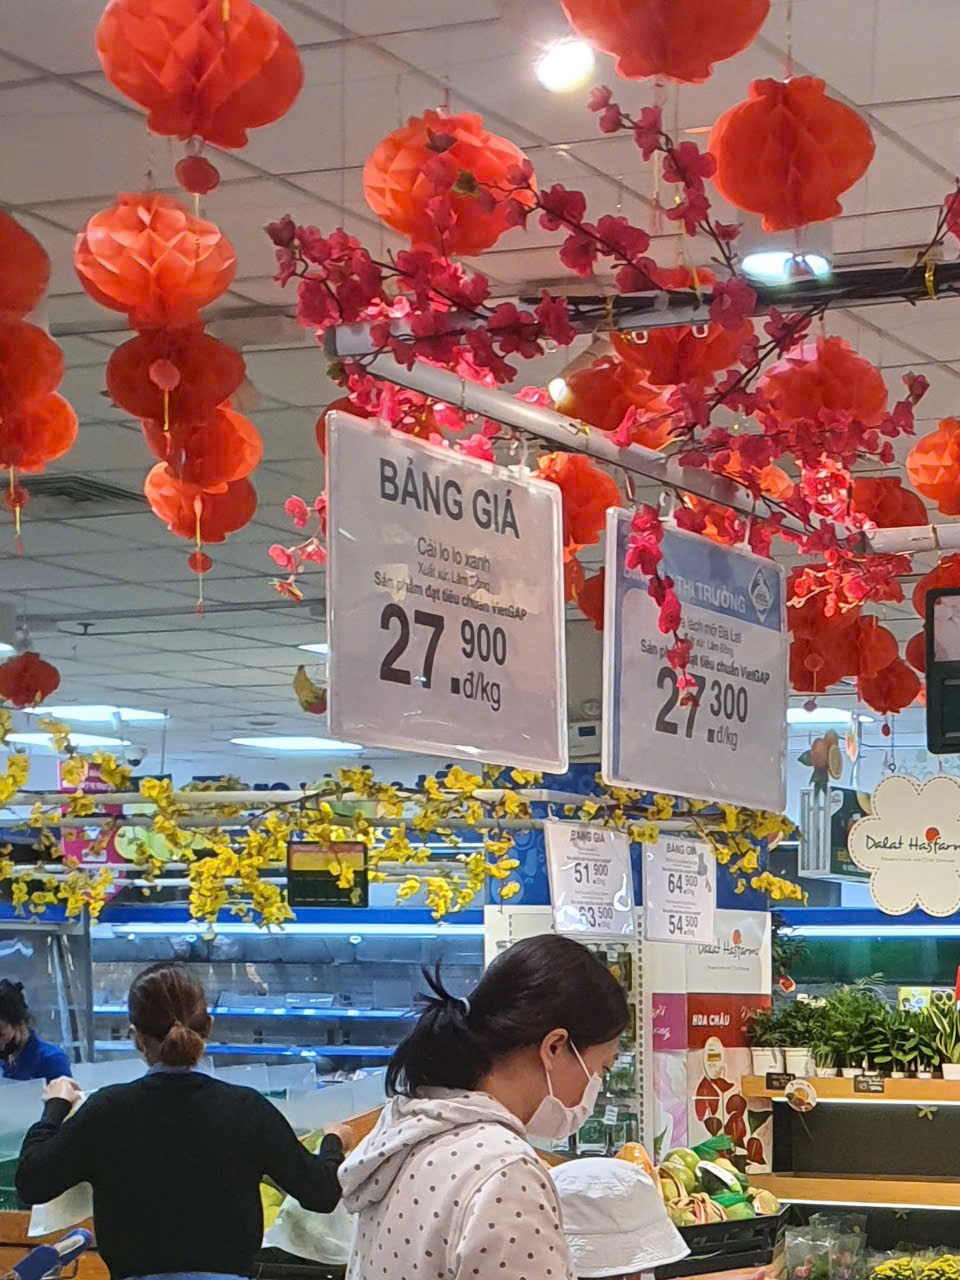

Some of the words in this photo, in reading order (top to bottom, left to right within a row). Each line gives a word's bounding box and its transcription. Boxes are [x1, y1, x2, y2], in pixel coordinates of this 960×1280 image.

[380, 457, 463, 521] BẢNG
[472, 489, 520, 539] GIÁ
[465, 554, 491, 573] xanh
[425, 584, 440, 602] đạt
[696, 581, 746, 615] TRƯỜNG
[380, 603, 445, 689] 27
[461, 619, 507, 666] 900
[656, 666, 706, 738] 27
[710, 680, 748, 723] 300
[865, 835, 903, 850] Dalat
[574, 862, 590, 884] 51
[593, 864, 608, 876] 900
[668, 873, 683, 893] 64
[598, 907, 613, 920] 500
[668, 915, 683, 935] 54
[692, 1014, 708, 1026] HOA
